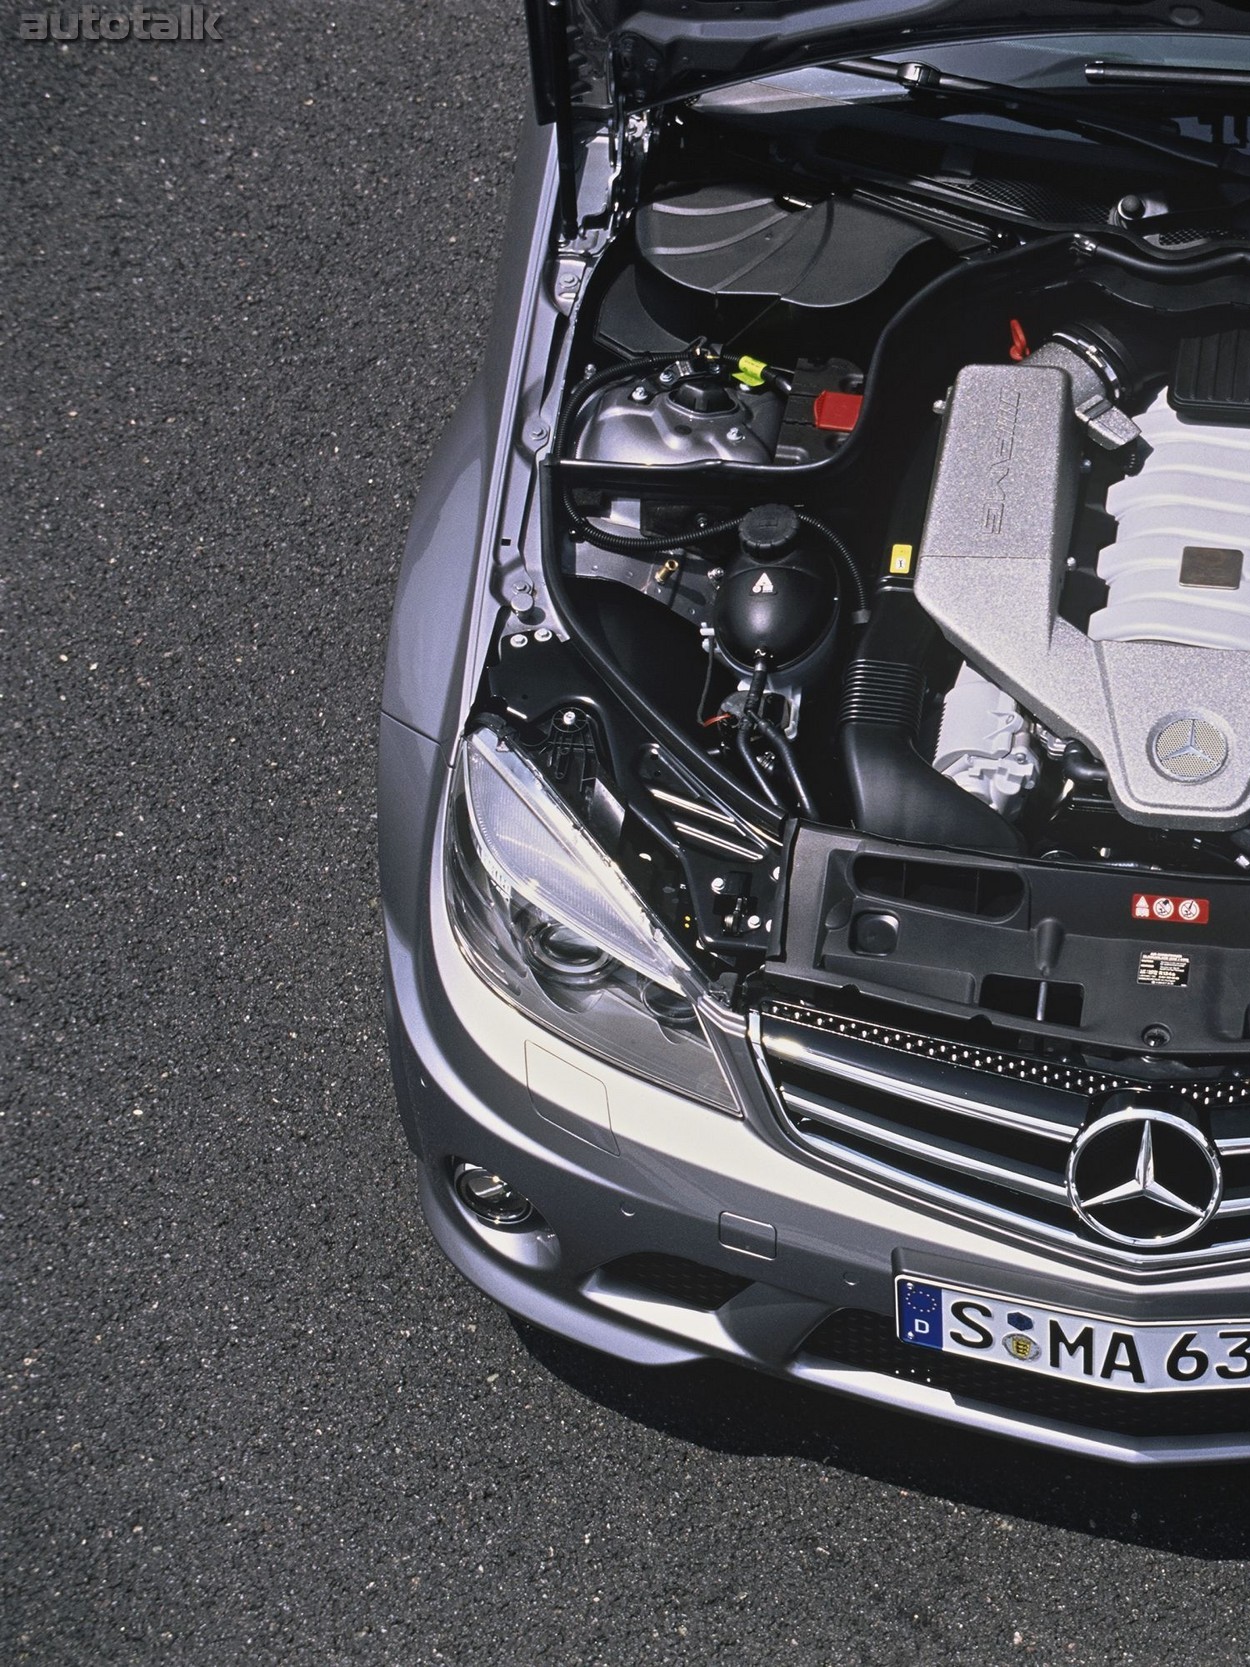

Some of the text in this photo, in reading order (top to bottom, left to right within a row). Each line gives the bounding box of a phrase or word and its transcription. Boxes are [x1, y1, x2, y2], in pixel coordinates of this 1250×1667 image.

[914, 1318, 930, 1335] D
[950, 1300, 993, 1350] S
[1049, 1318, 1146, 1384] MA
